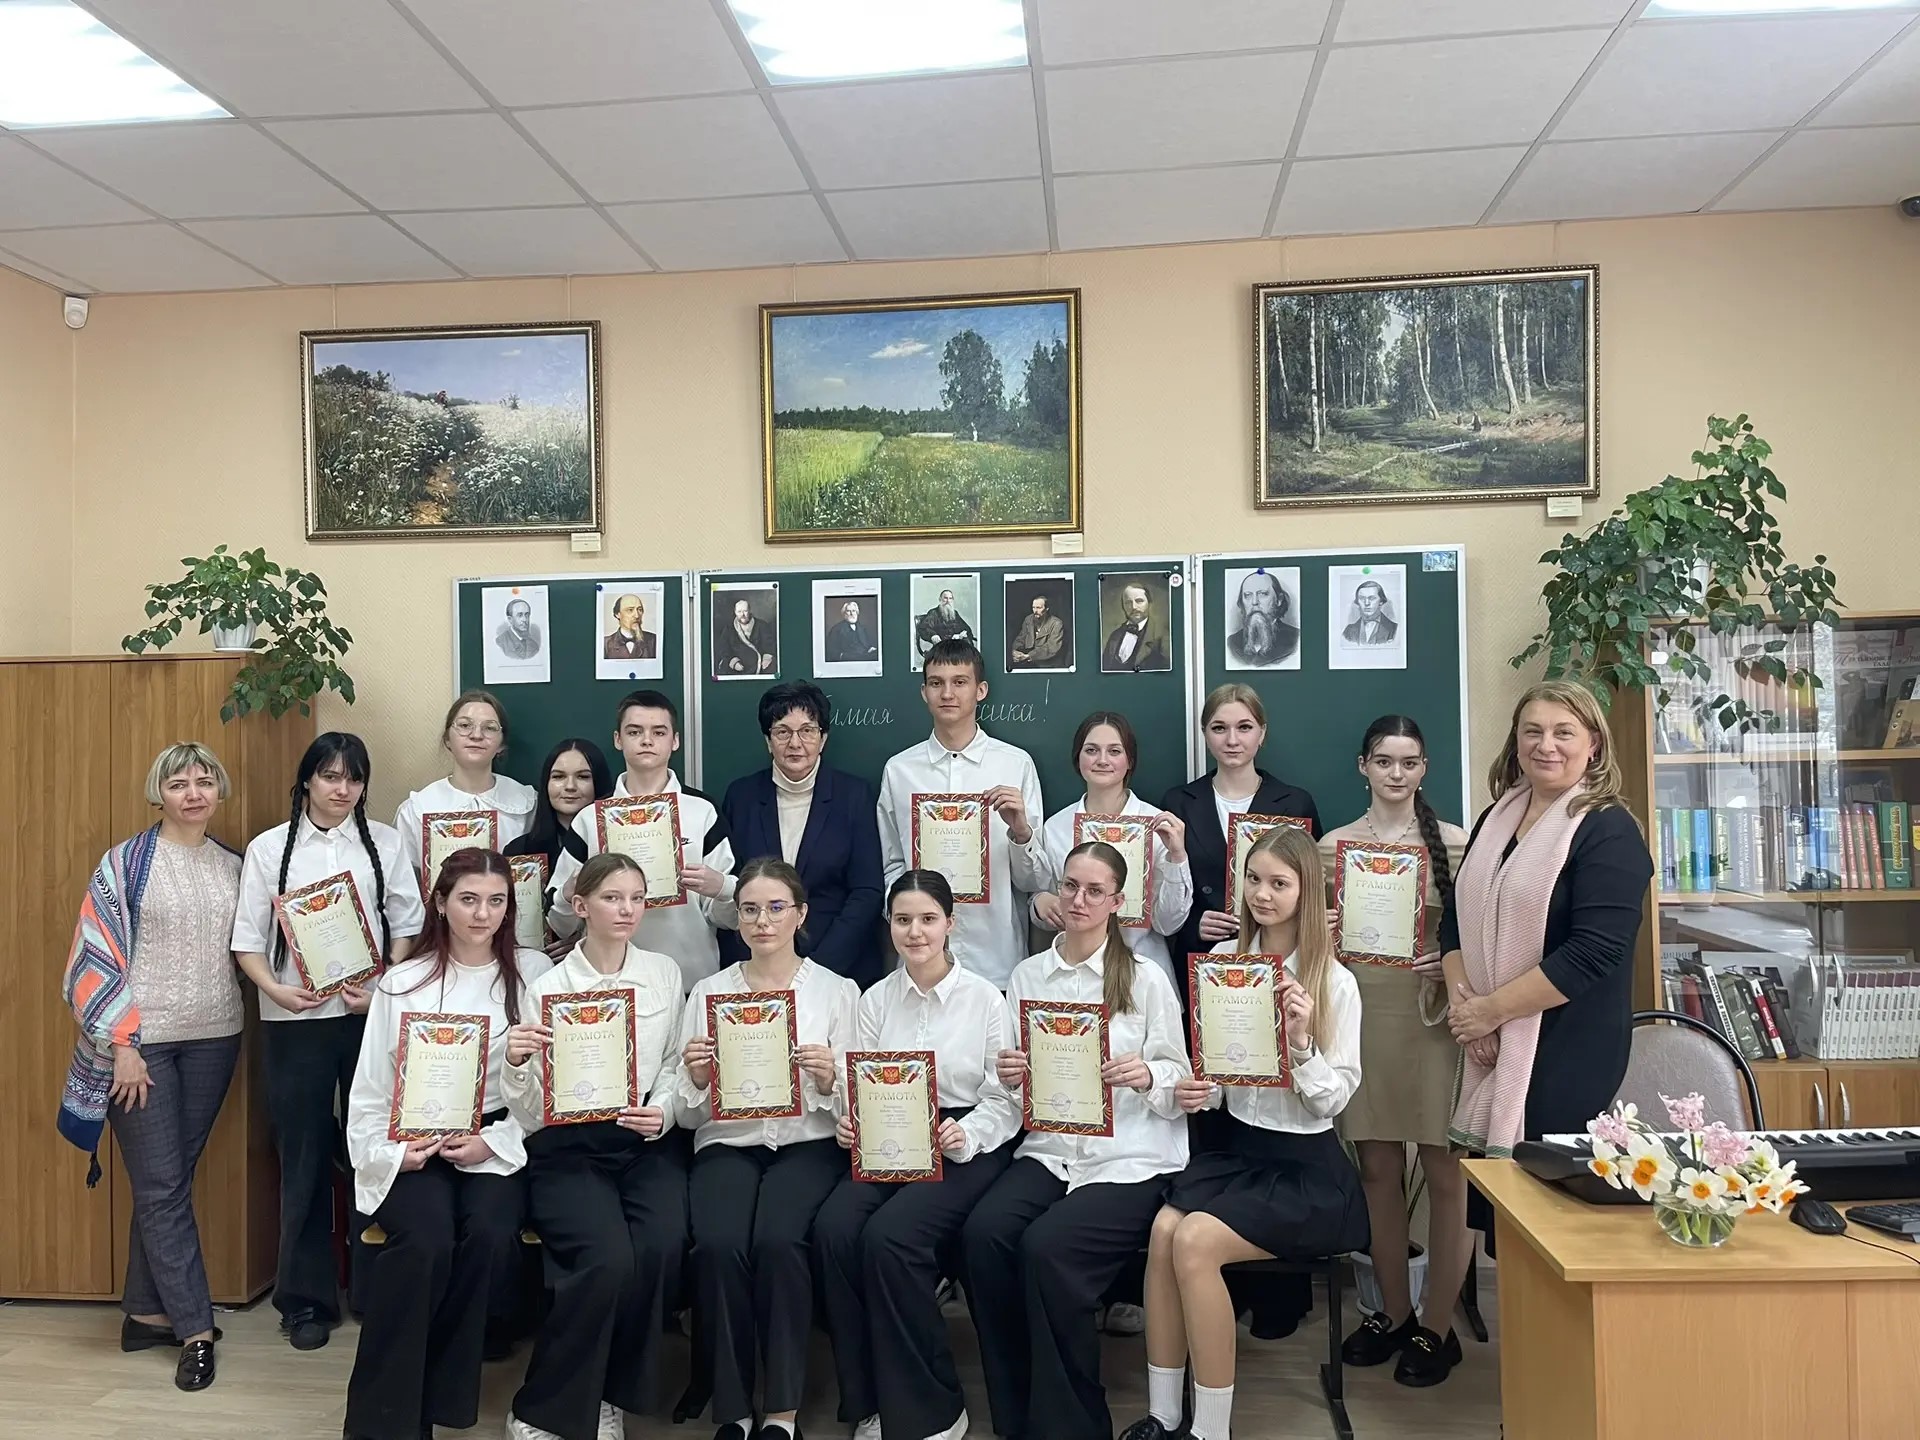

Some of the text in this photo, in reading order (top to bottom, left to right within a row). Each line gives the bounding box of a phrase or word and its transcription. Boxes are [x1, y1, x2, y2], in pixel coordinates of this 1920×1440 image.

[617, 830, 662, 841] ГРАМОТА
[929, 827, 972, 835] ГРАМОТА
[1355, 879, 1405, 891] ГРАМОТА
[303, 909, 346, 930] ГРАМОТА
[1211, 995, 1263, 1005] ГРАМОТА
[564, 1030, 615, 1042] ГРАМОТА
[728, 1031, 777, 1041] ГРАМОТА
[1040, 1041, 1089, 1053] ГРАМОТА
[418, 1051, 468, 1061] ГРАМОТА
[868, 1091, 917, 1101] ГРАМОТА
